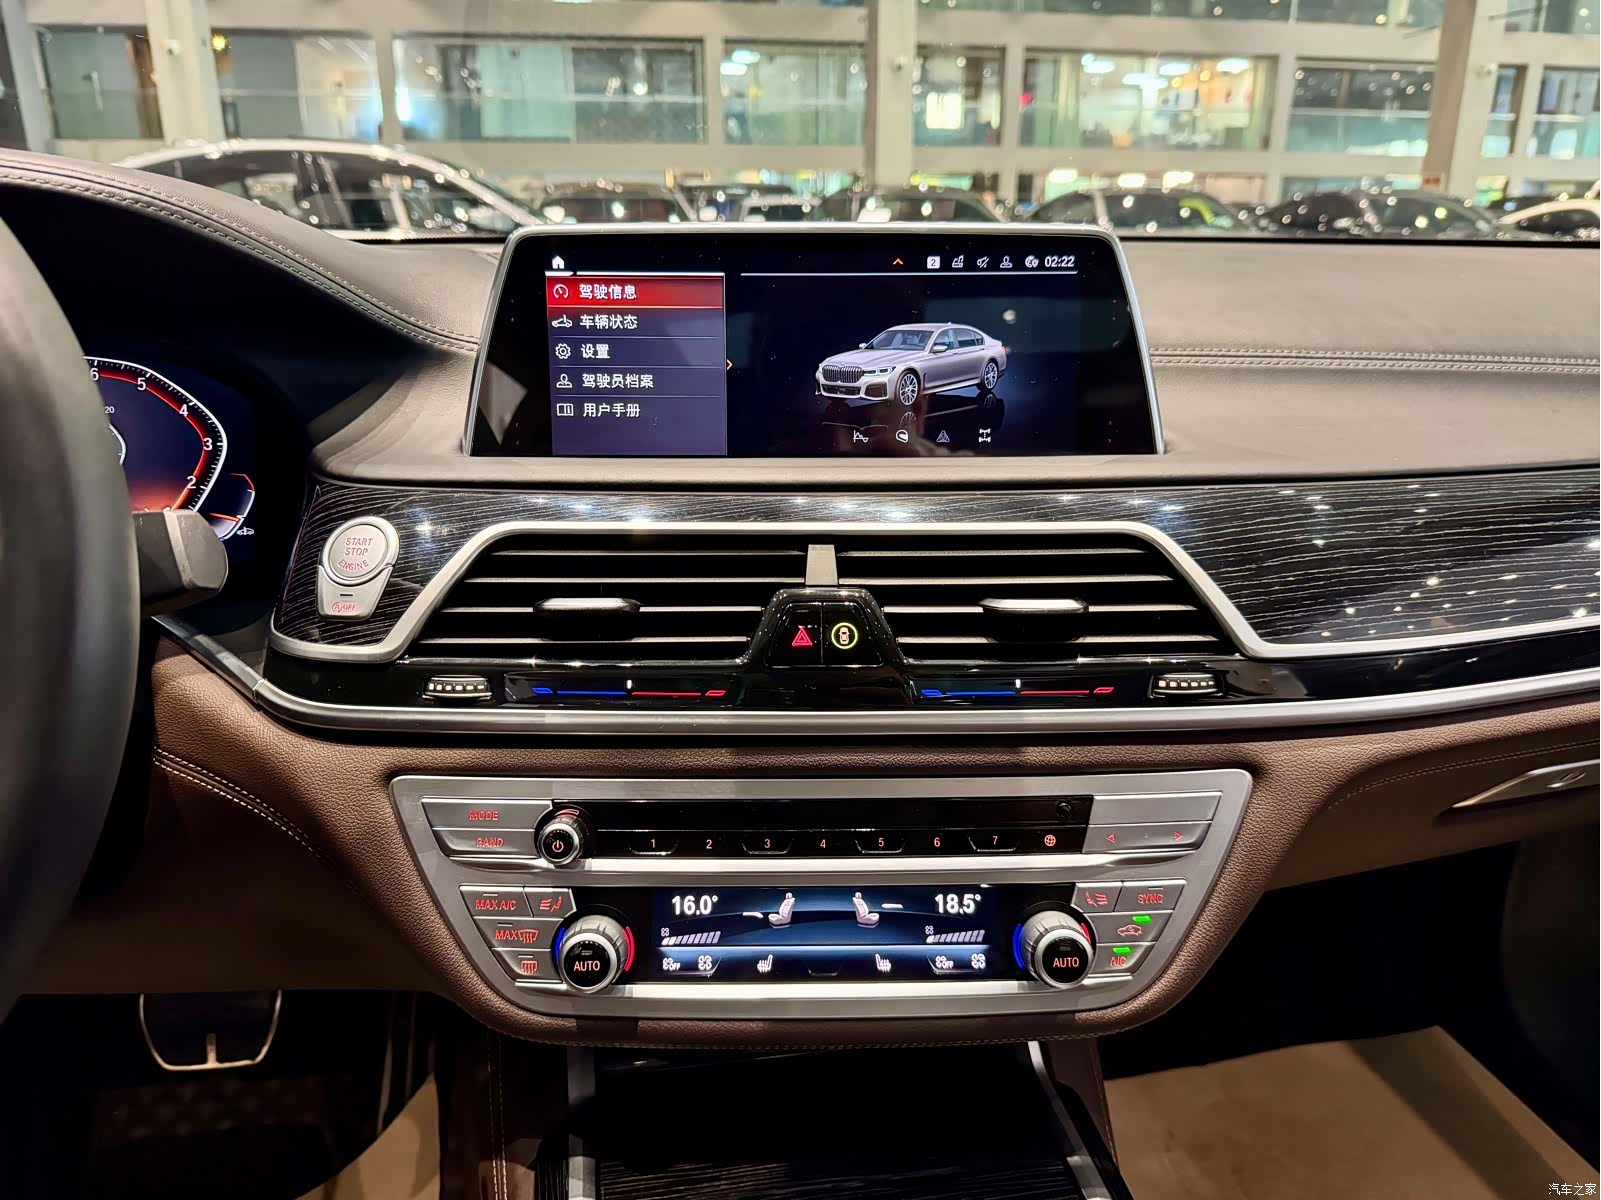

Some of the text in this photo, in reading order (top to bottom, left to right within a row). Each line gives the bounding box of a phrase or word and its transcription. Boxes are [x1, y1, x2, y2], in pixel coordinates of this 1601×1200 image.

[930, 258, 937, 267] 2
[1044, 255, 1075, 268] 02:22
[579, 284, 637, 300] 驾驶信息
[580, 314, 638, 330] 车辆状态
[580, 344, 611, 359] 设置
[89, 367, 100, 381] 6
[137, 377, 147, 391] 5
[582, 373, 654, 389] 驾驶员档案
[179, 404, 189, 417] 4
[583, 403, 641, 418] 用户手册
[203, 437, 213, 451] 3
[186, 475, 197, 489] 2
[345, 537, 373, 546] START
[344, 547, 368, 556] STOP
[339, 559, 369, 571] ENGINE
[469, 810, 498, 821] MODE
[476, 837, 504, 847] BAND
[650, 838, 656, 848] 1
[706, 839, 713, 849] 2
[764, 838, 771, 848] 3
[820, 838, 826, 848] 4
[878, 837, 885, 847] 5
[933, 837, 941, 847] 6
[992, 835, 998, 845] 7
[1137, 893, 1164, 904] SYNC
[475, 899, 516, 910] MAX A/C
[495, 929, 518, 940] MAX
[573, 960, 600, 971] AUTO
[1053, 957, 1080, 968] AUTO
[1110, 956, 1127, 967] A/C
